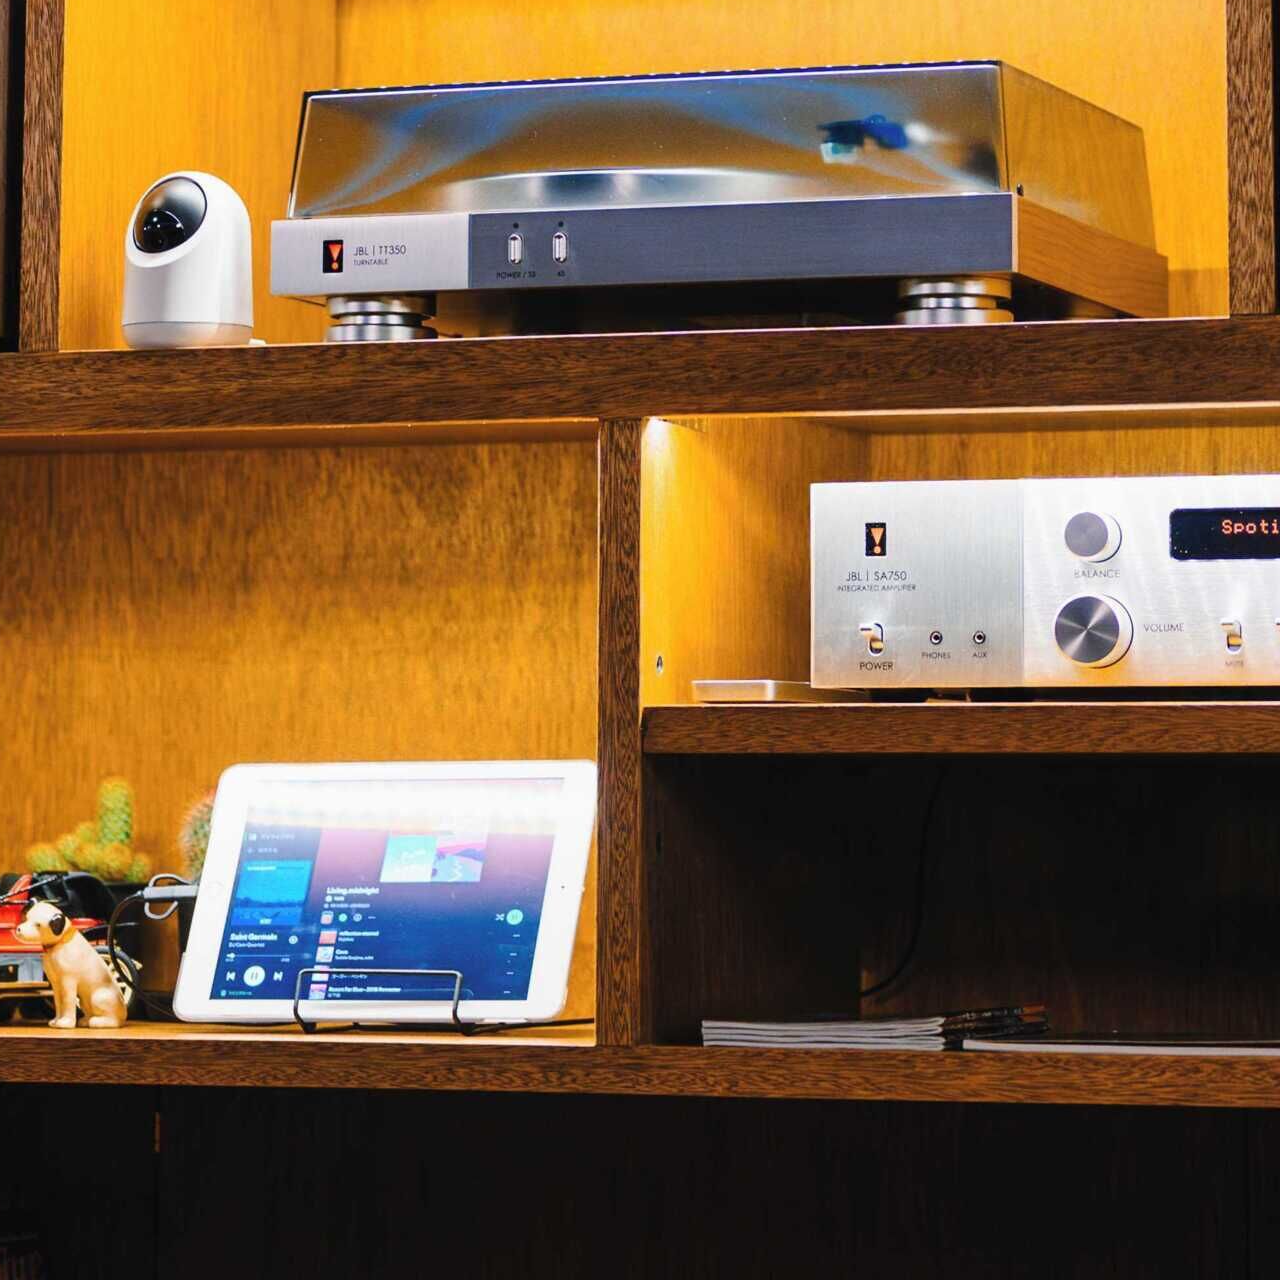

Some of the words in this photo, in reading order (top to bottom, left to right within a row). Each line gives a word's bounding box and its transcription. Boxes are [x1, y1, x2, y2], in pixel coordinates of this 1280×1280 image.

[353, 246, 369, 257] JBL
[378, 245, 407, 255] TT350
[353, 258, 389, 266] TURNTABLE
[845, 571, 863, 582] JBL
[873, 571, 907, 581] SA750
[1074, 568, 1121, 578] BALANCE
[1143, 623, 1185, 633] VOLUME
[859, 661, 894, 671] POWER
